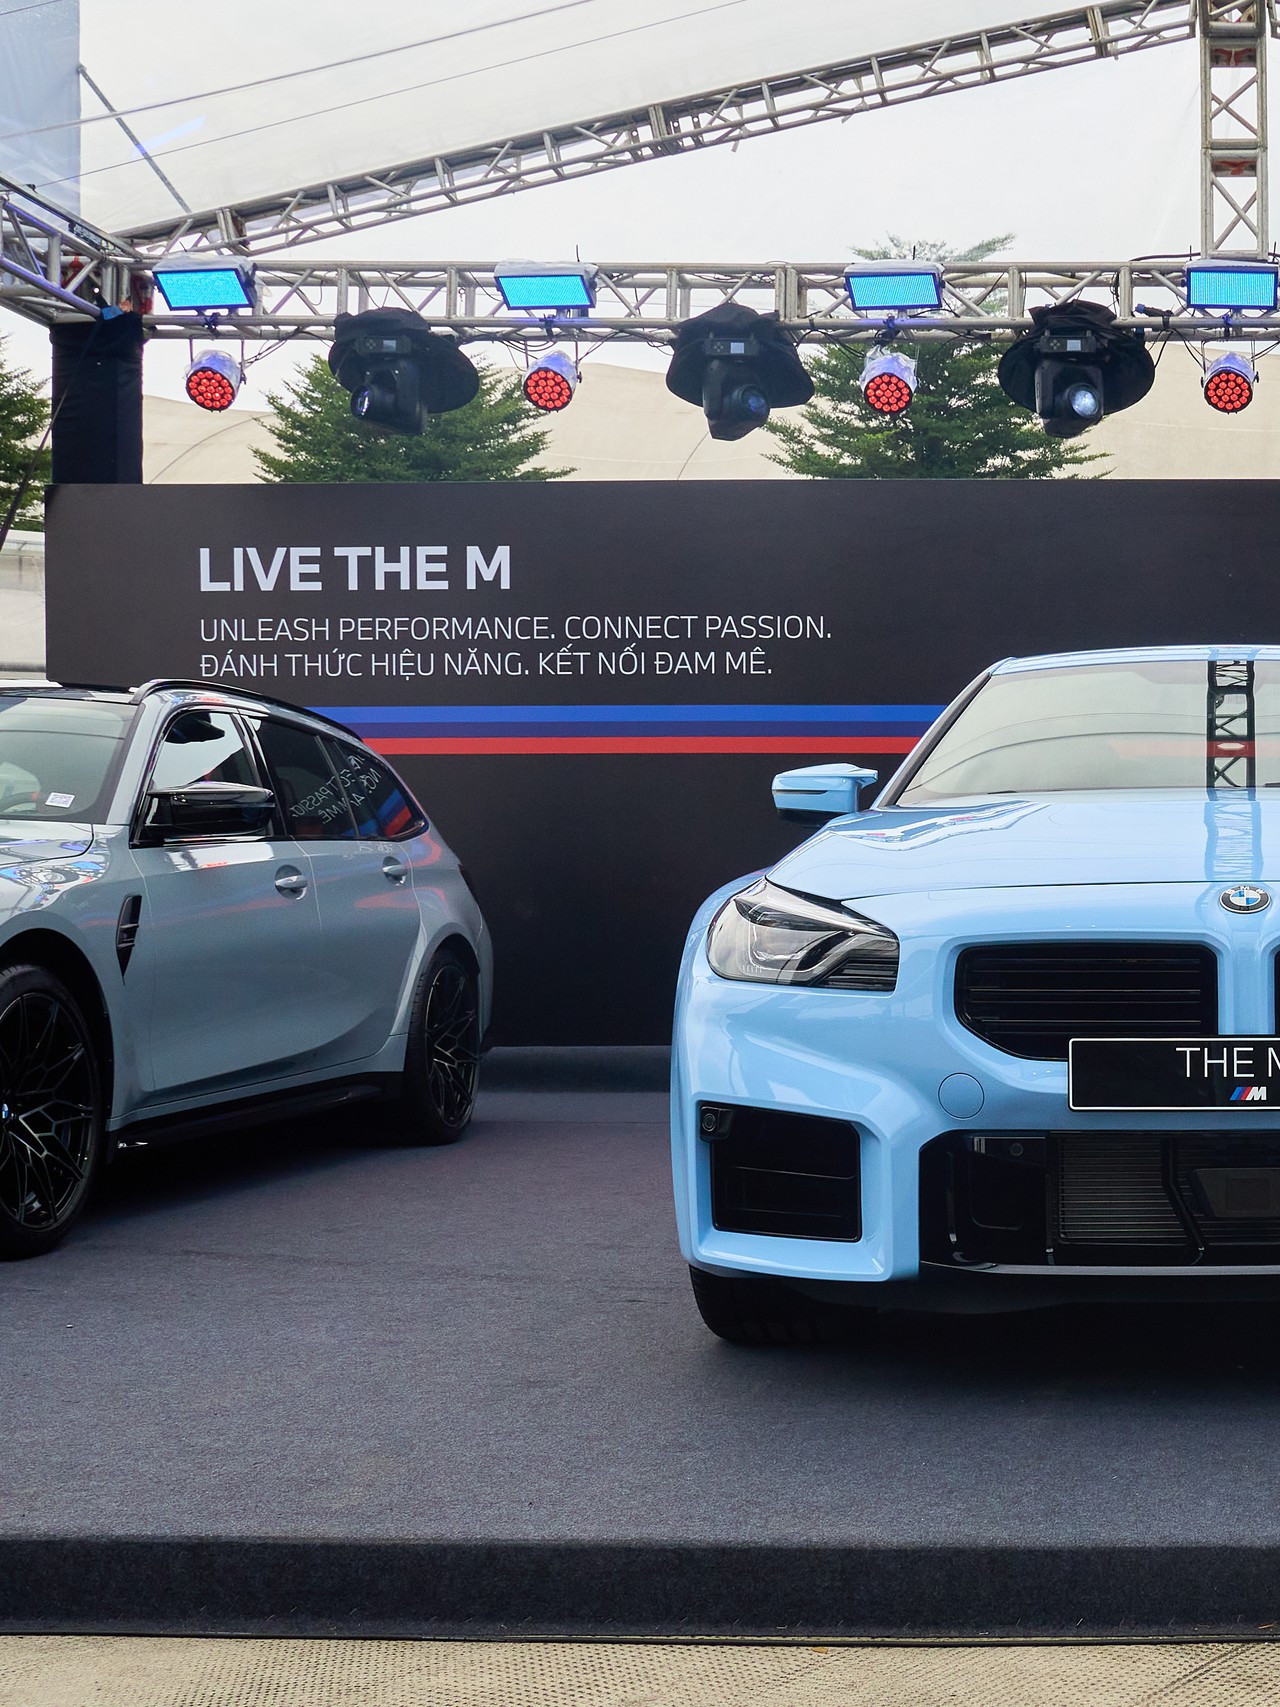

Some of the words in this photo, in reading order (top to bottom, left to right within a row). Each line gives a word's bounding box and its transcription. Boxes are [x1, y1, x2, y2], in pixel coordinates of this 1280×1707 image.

[200, 547, 322, 591] LIVE
[334, 546, 449, 590] THE
[467, 546, 511, 589] M
[200, 617, 330, 642] UNLEASH
[339, 616, 556, 641] PERFORMANCE.
[564, 615, 699, 640] CONNECT
[705, 615, 832, 639] PASSION.
[199, 648, 280, 677] ĐÁNH
[285, 648, 363, 677] THỨC
[371, 648, 434, 681] HIỆU
[444, 647, 530, 676] NĂNG.
[539, 643, 591, 675] KẾT
[598, 643, 646, 675] NỐI
[654, 651, 716, 675] ĐAM
[725, 646, 773, 675] MÊ.
[1175, 1047, 1255, 1078] THE
